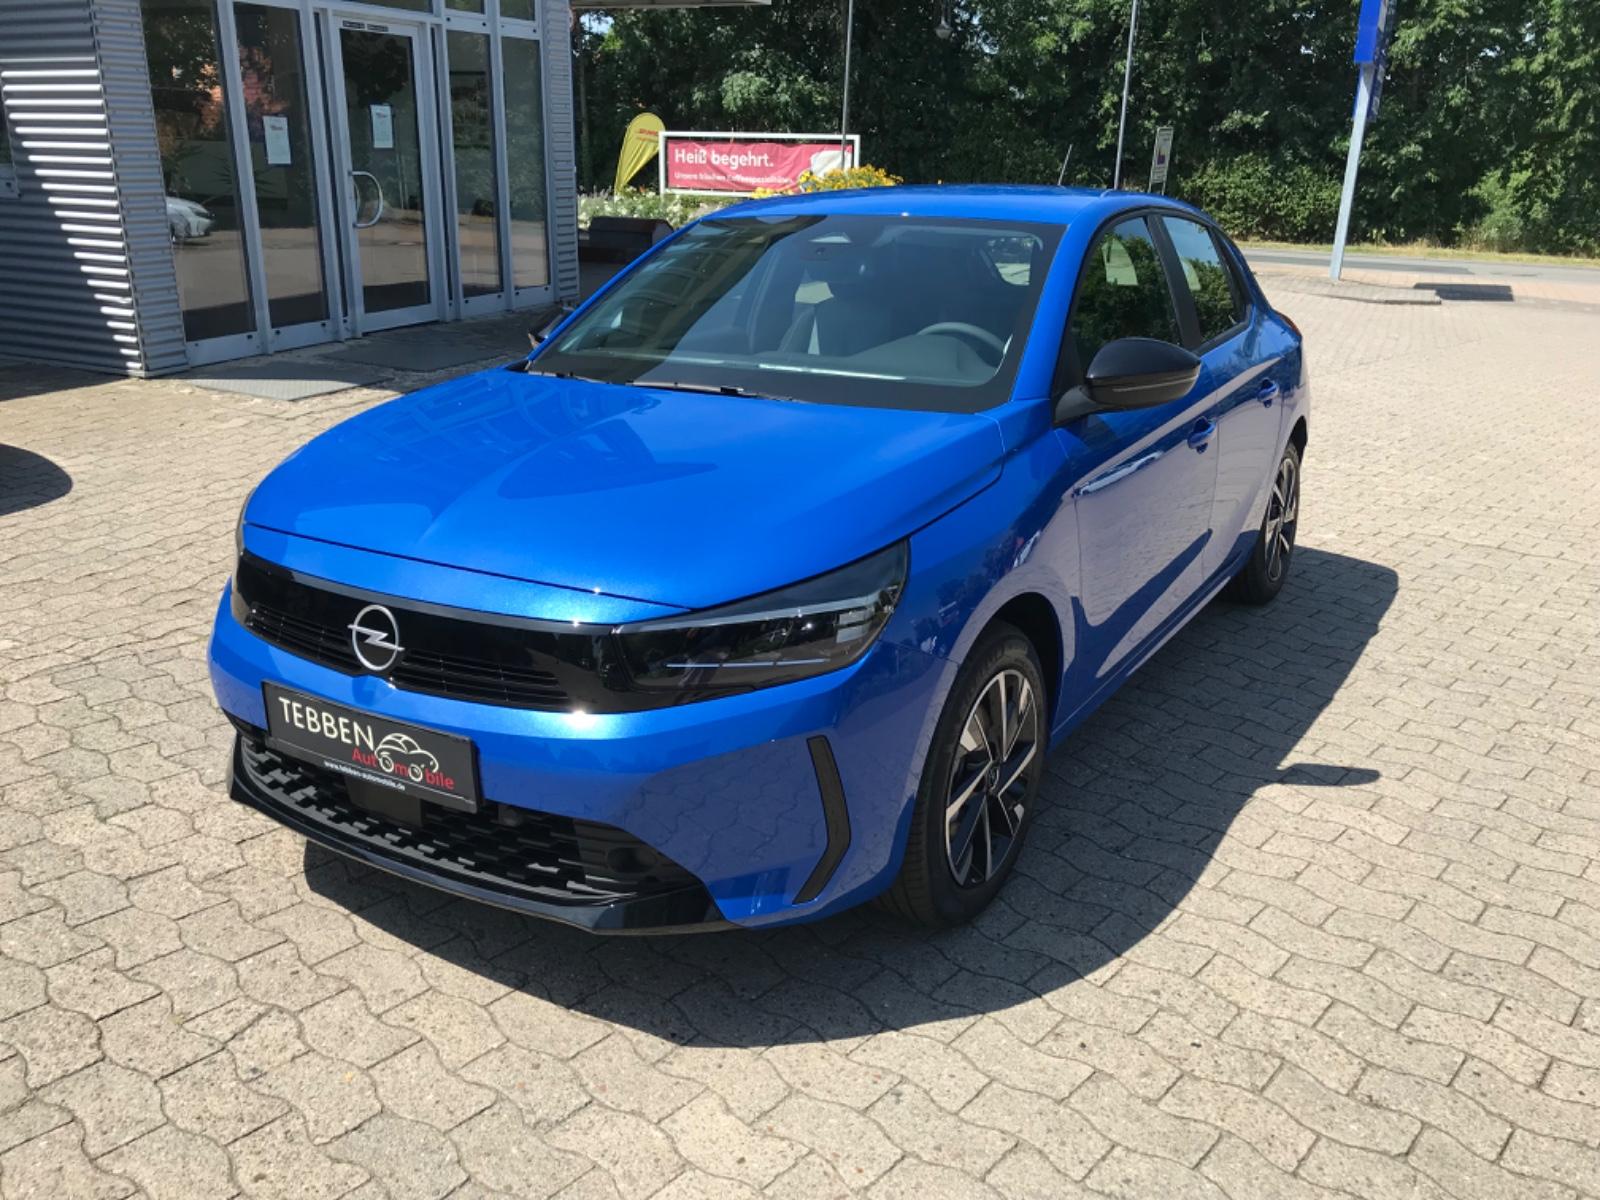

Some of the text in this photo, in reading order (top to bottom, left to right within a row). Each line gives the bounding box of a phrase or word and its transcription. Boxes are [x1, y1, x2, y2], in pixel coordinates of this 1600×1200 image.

[674, 148, 775, 170] Heiß begehrt.
[278, 696, 375, 751] TEBBEN
